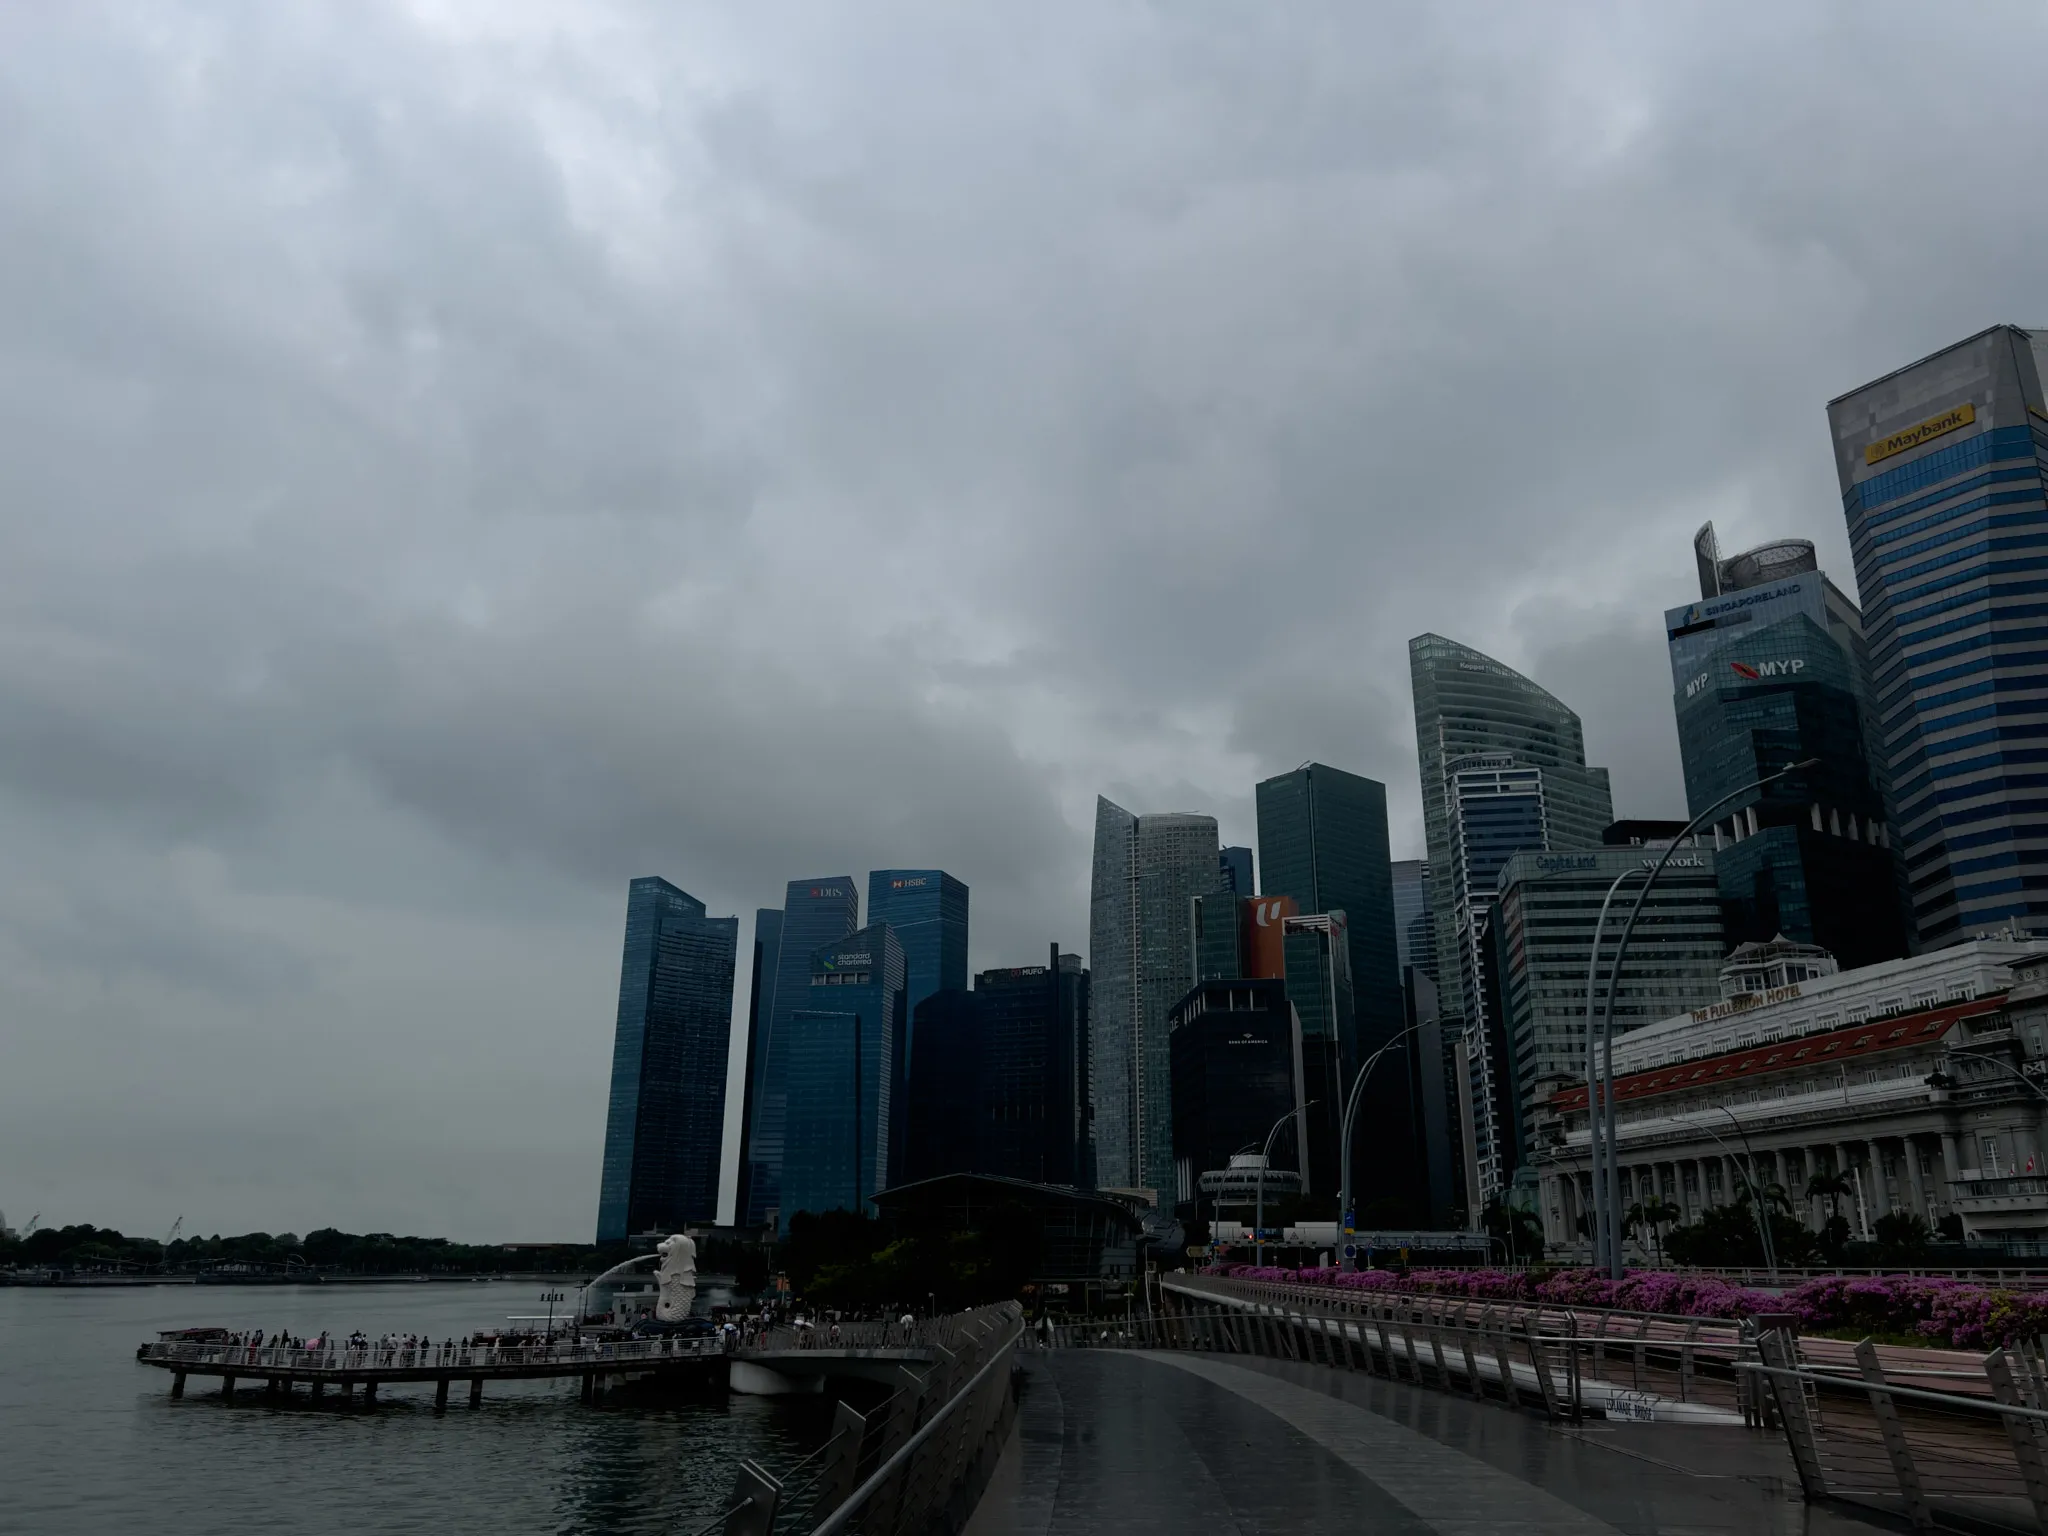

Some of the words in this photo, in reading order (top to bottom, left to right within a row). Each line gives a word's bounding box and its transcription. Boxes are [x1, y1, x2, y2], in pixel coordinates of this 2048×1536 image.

[1887, 412, 1963, 452] Maybank
[1759, 659, 1805, 677] MYP
[1687, 672, 1709, 698] MYP
[1536, 855, 1597, 871] CapitaLand
[904, 877, 927, 887] HSBC
[820, 887, 842, 897] DBS
[1022, 967, 1044, 976] MUFG
[1690, 1008, 1708, 1023] THE
[1710, 994, 1764, 1018] FULLERTON
[1766, 984, 1802, 1004] HOTEL
